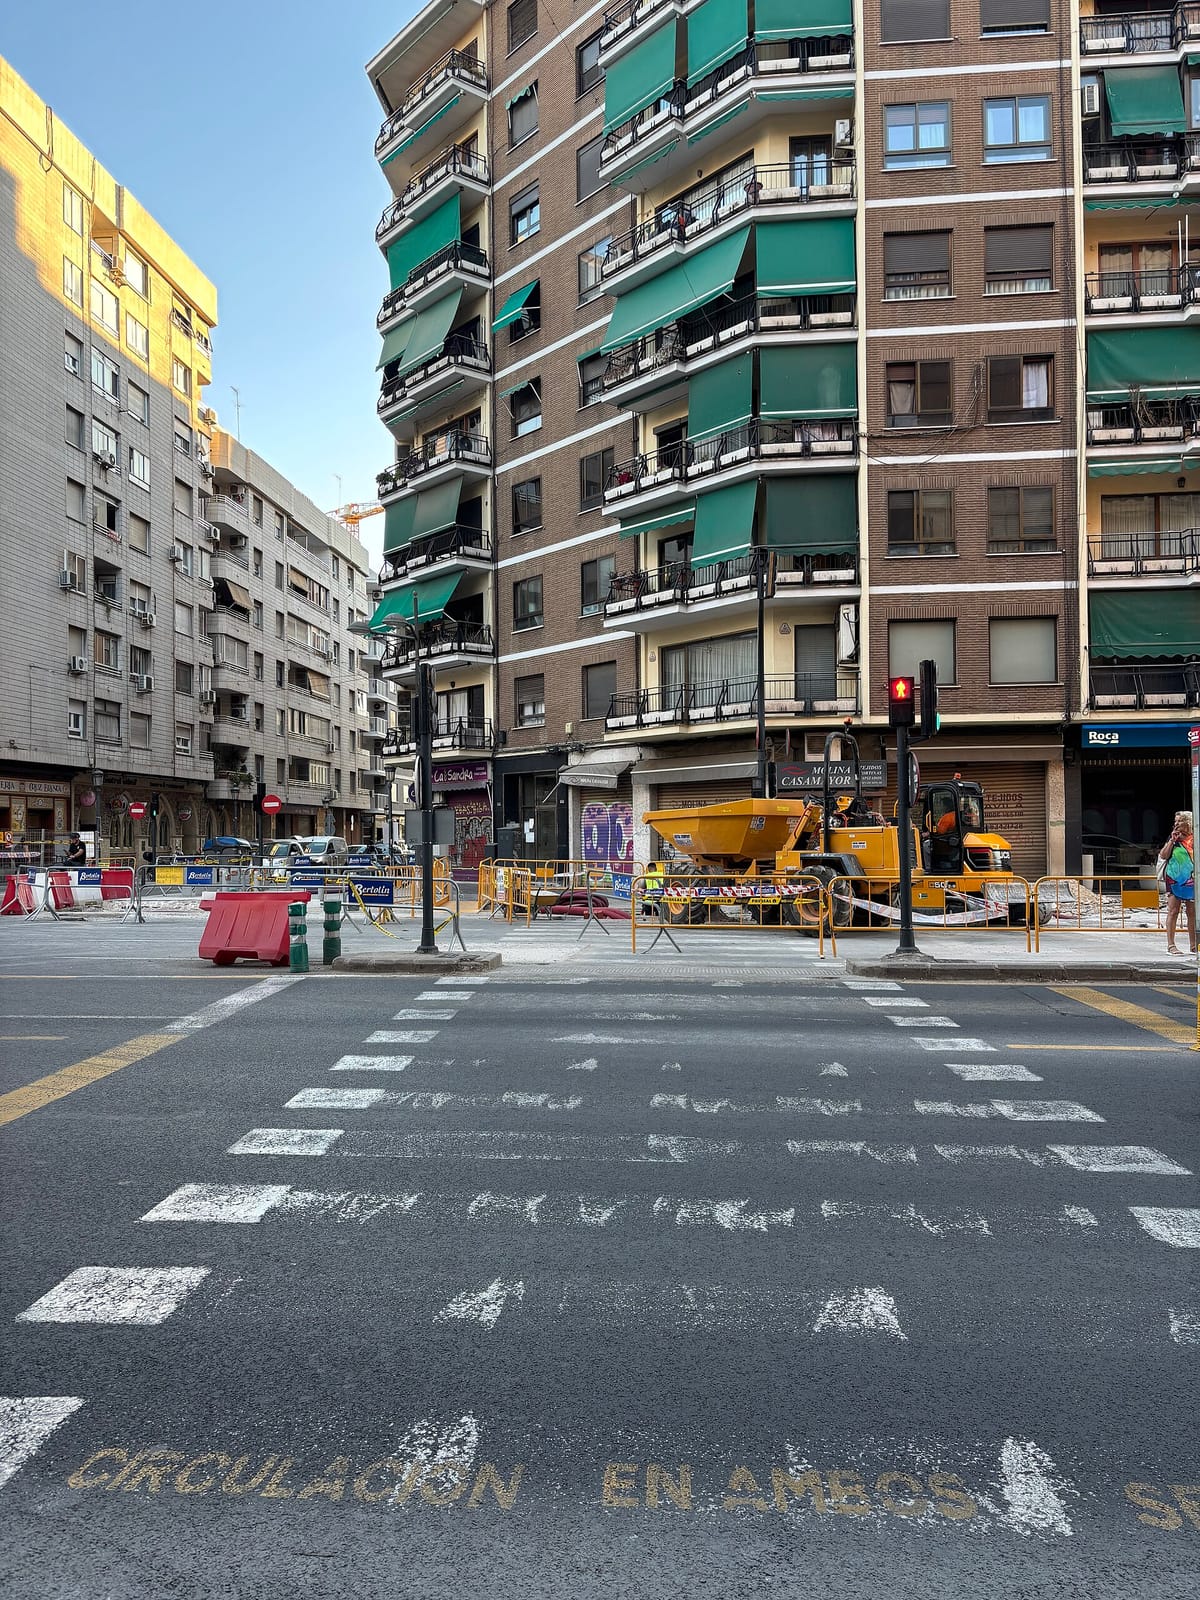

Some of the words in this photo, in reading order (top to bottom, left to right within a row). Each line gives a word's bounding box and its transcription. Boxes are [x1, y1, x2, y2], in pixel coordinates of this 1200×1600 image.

[1088, 731, 1119, 741] Roca
[781, 776, 851, 786] CASAMYOR
[351, 883, 390, 898] Bertolin
[67, 1447, 527, 1510] CIRCULACION
[602, 1462, 693, 1511] EN
[722, 1465, 980, 1521] AMBOS
